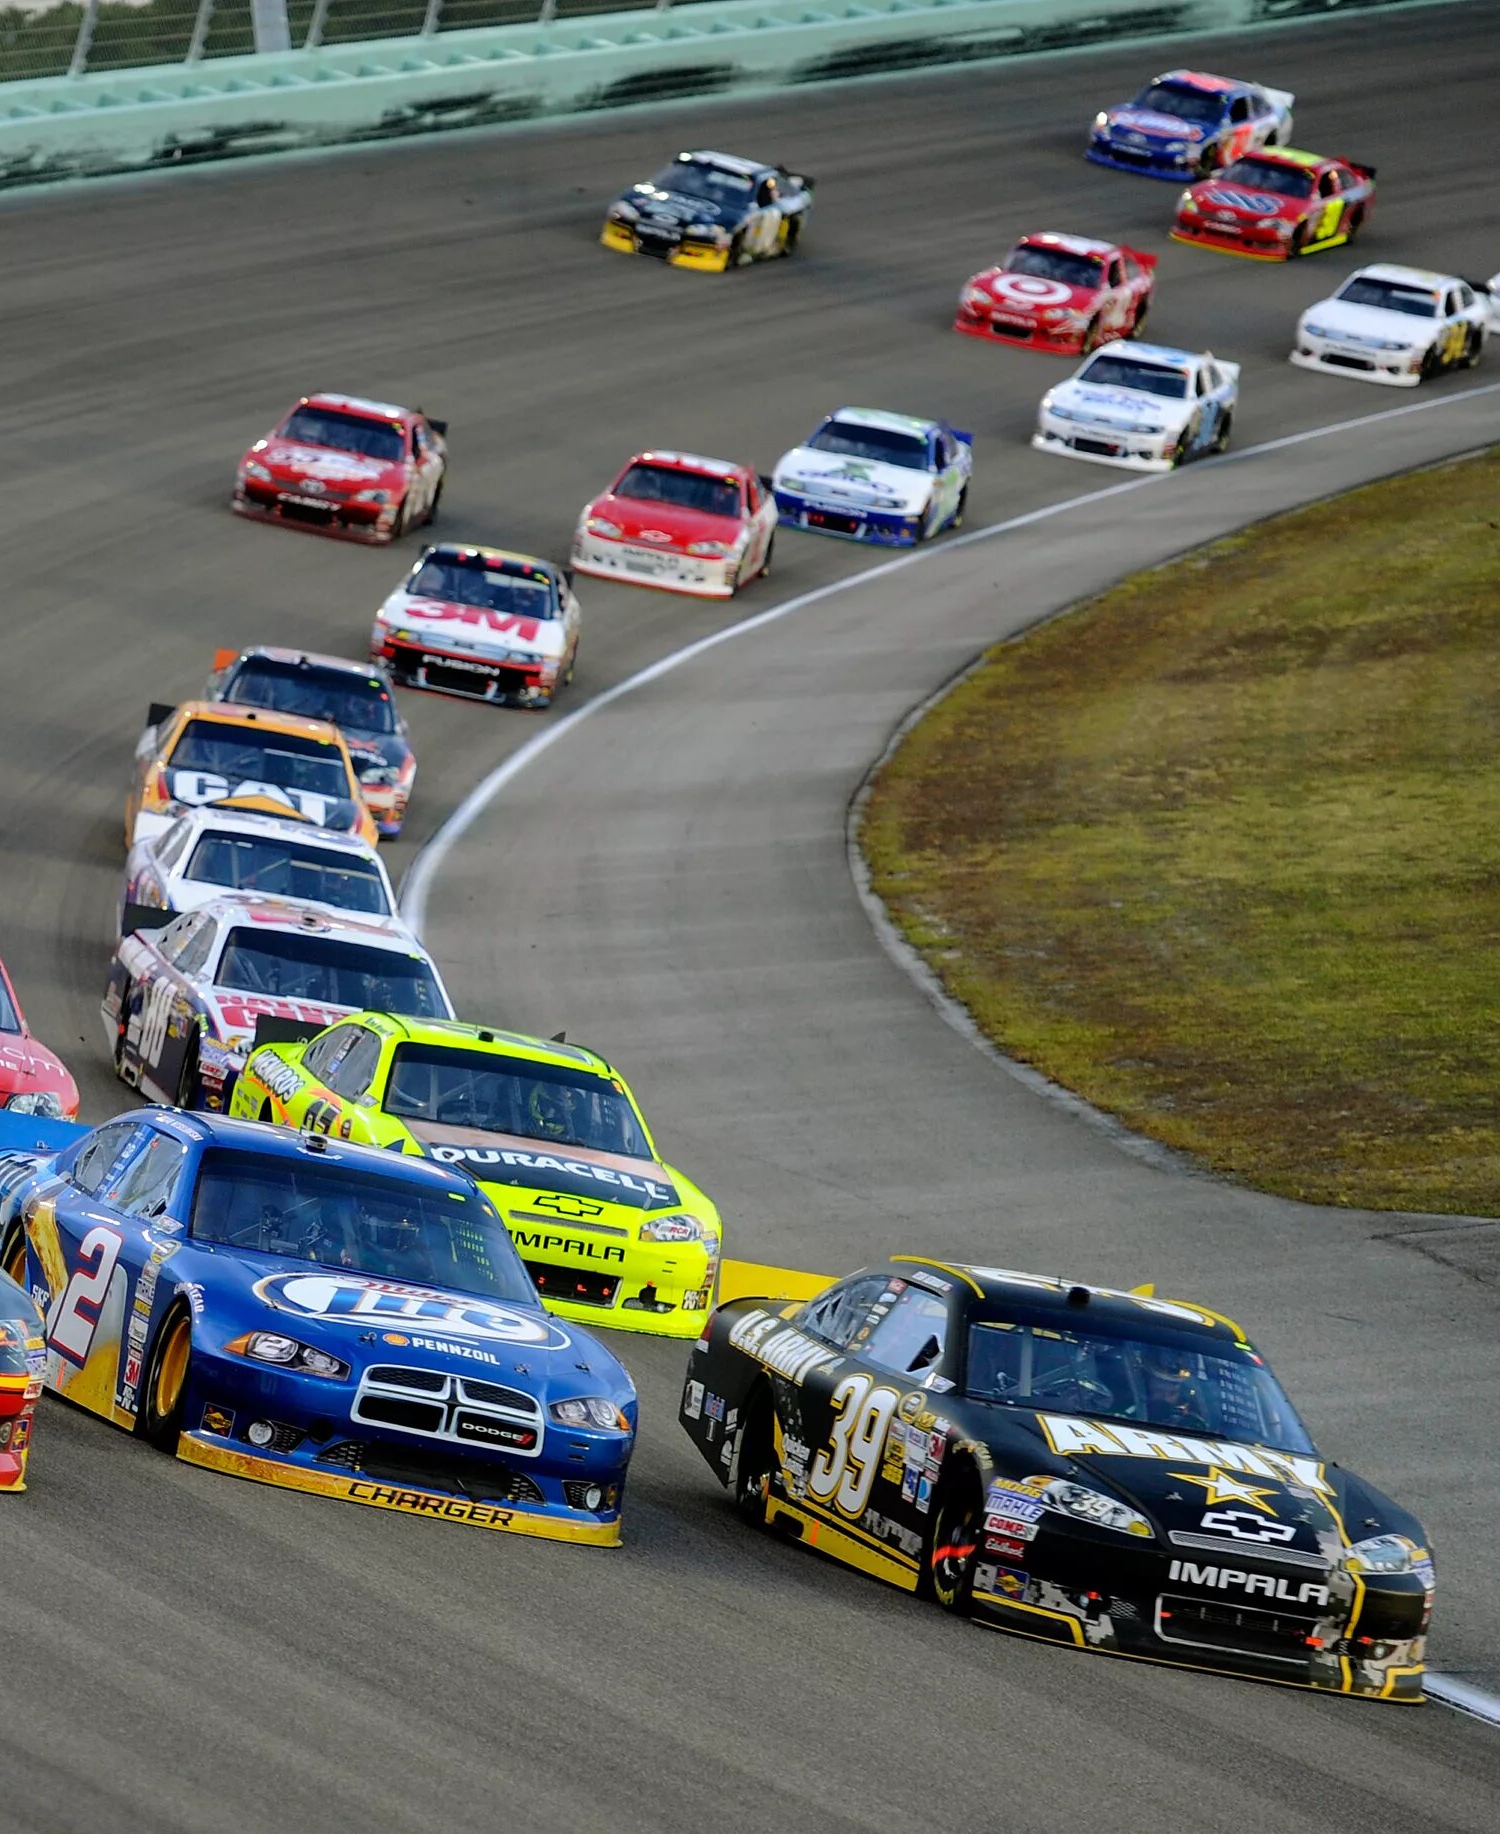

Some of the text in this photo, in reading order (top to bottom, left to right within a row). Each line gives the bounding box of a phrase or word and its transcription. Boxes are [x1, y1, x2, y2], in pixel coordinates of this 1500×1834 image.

[405, 598, 541, 642] 3M
[421, 653, 501, 677] FUSION
[172, 769, 338, 826] CAT
[251, 1048, 306, 1104] MENARDS
[430, 1146, 672, 1202] DURACELL
[31, 1284, 50, 1308] SKF
[51, 1227, 124, 1370] 2
[412, 1336, 501, 1366] PENNZOIL
[729, 1308, 840, 1387] U.S. ARMY
[125, 1358, 140, 1388] 3M
[462, 1422, 525, 1442] DODGE
[808, 1372, 902, 1520] 39
[1036, 1413, 1338, 1498] ARMY
[347, 1481, 515, 1527] CHARGER
[988, 1496, 1042, 1521] MAHLE
[994, 1477, 1045, 1499] MOOG
[1070, 1494, 1113, 1517] 39
[988, 1514, 1024, 1534] COMP
[1168, 1560, 1330, 1607] IMPALA
